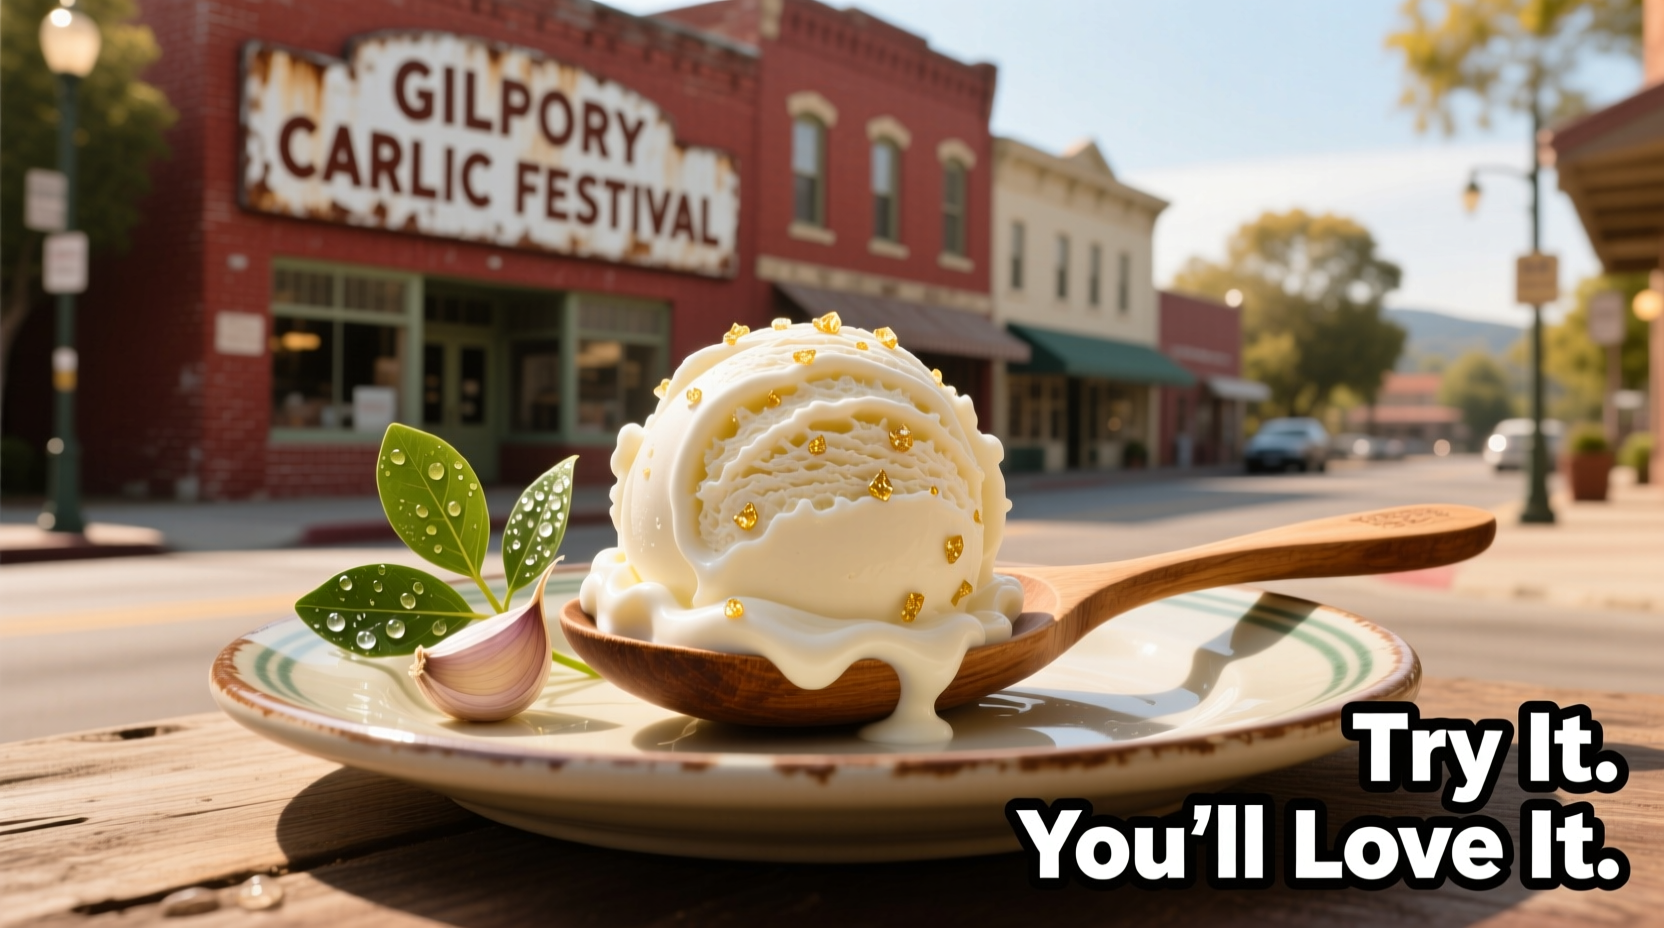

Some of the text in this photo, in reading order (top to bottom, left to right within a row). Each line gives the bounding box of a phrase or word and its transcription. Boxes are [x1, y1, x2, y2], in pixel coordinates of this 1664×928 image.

[394, 60, 645, 166] GILPORY
[278, 116, 720, 247] CARLIC FESTIVAL
